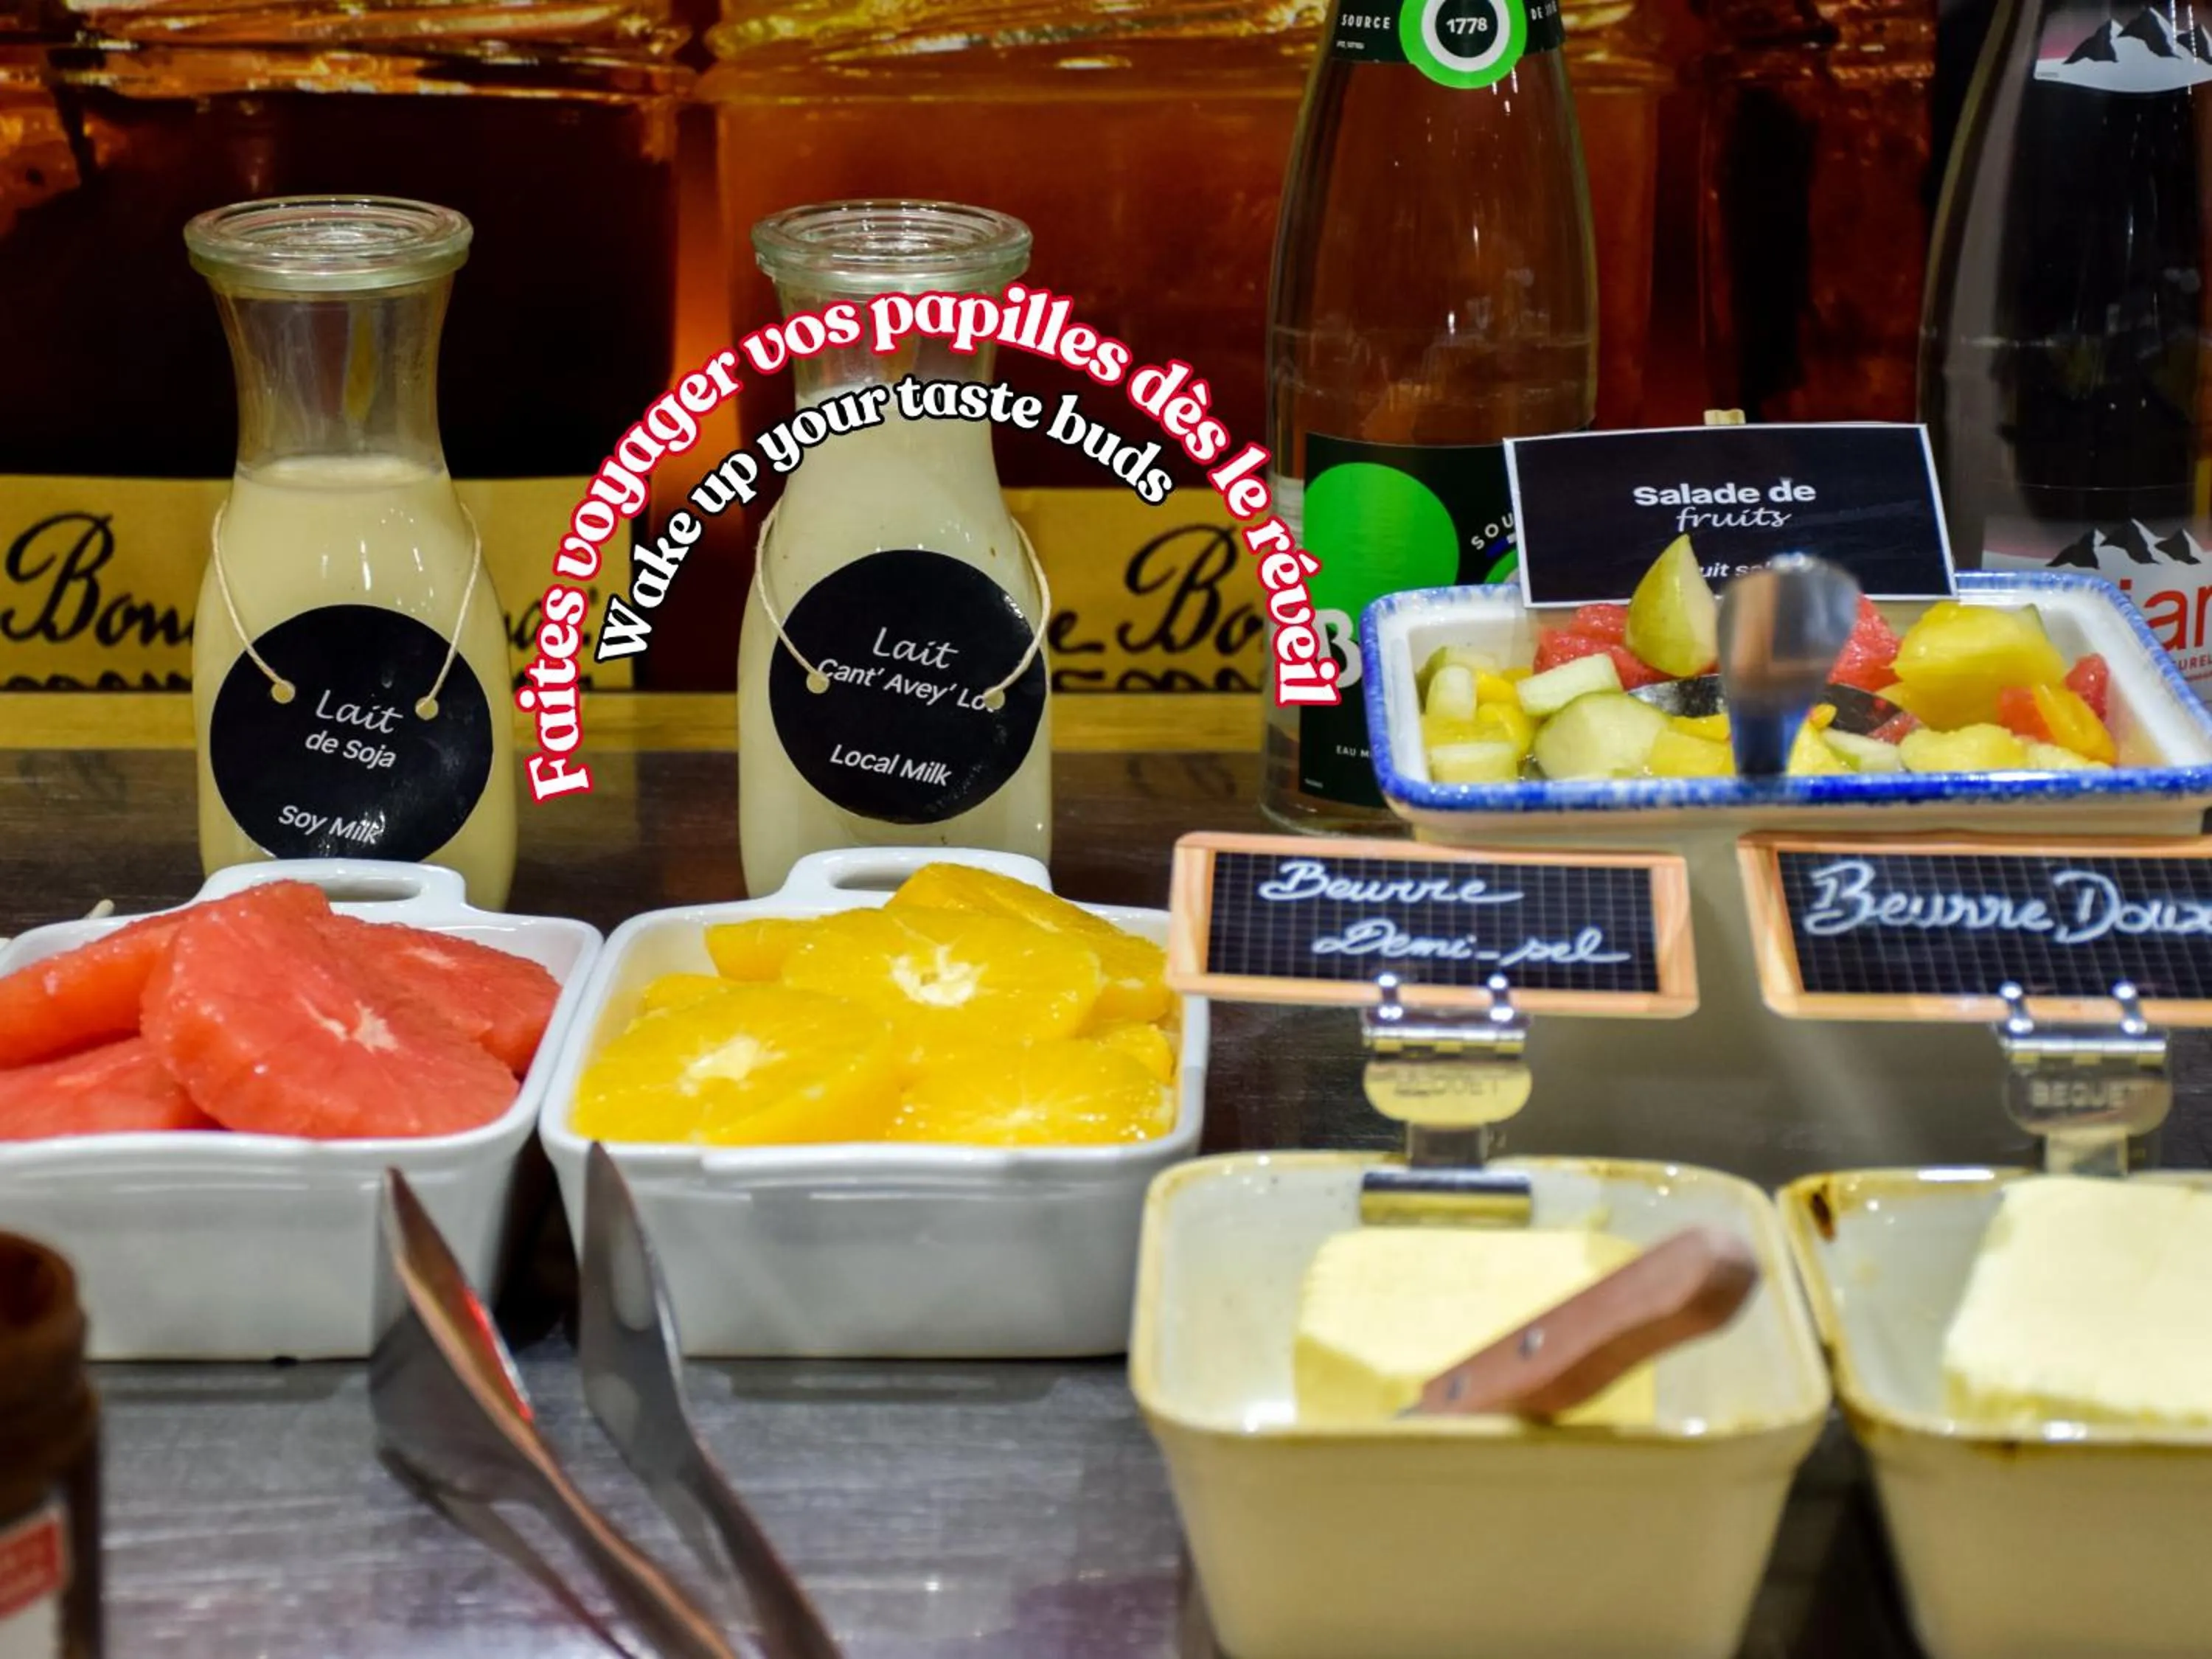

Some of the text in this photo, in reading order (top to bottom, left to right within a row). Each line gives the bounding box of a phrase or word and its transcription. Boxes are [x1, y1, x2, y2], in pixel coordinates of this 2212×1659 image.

[1340, 13, 1391, 29] SOURCE
[1446, 18, 1489, 35] 1778
[1632, 478, 1817, 507] Salade de
[1676, 505, 1793, 532] fruits
[872, 627, 959, 669] Lait
[817, 658, 995, 713] Cant' Avey' Lo
[315, 689, 404, 734] Lait
[305, 729, 397, 770] de Soja
[830, 743, 953, 787] Local Milk
[277, 804, 379, 845] Soy Milk
[1258, 860, 1525, 904] Beurre
[1803, 860, 2055, 937] Beurre
